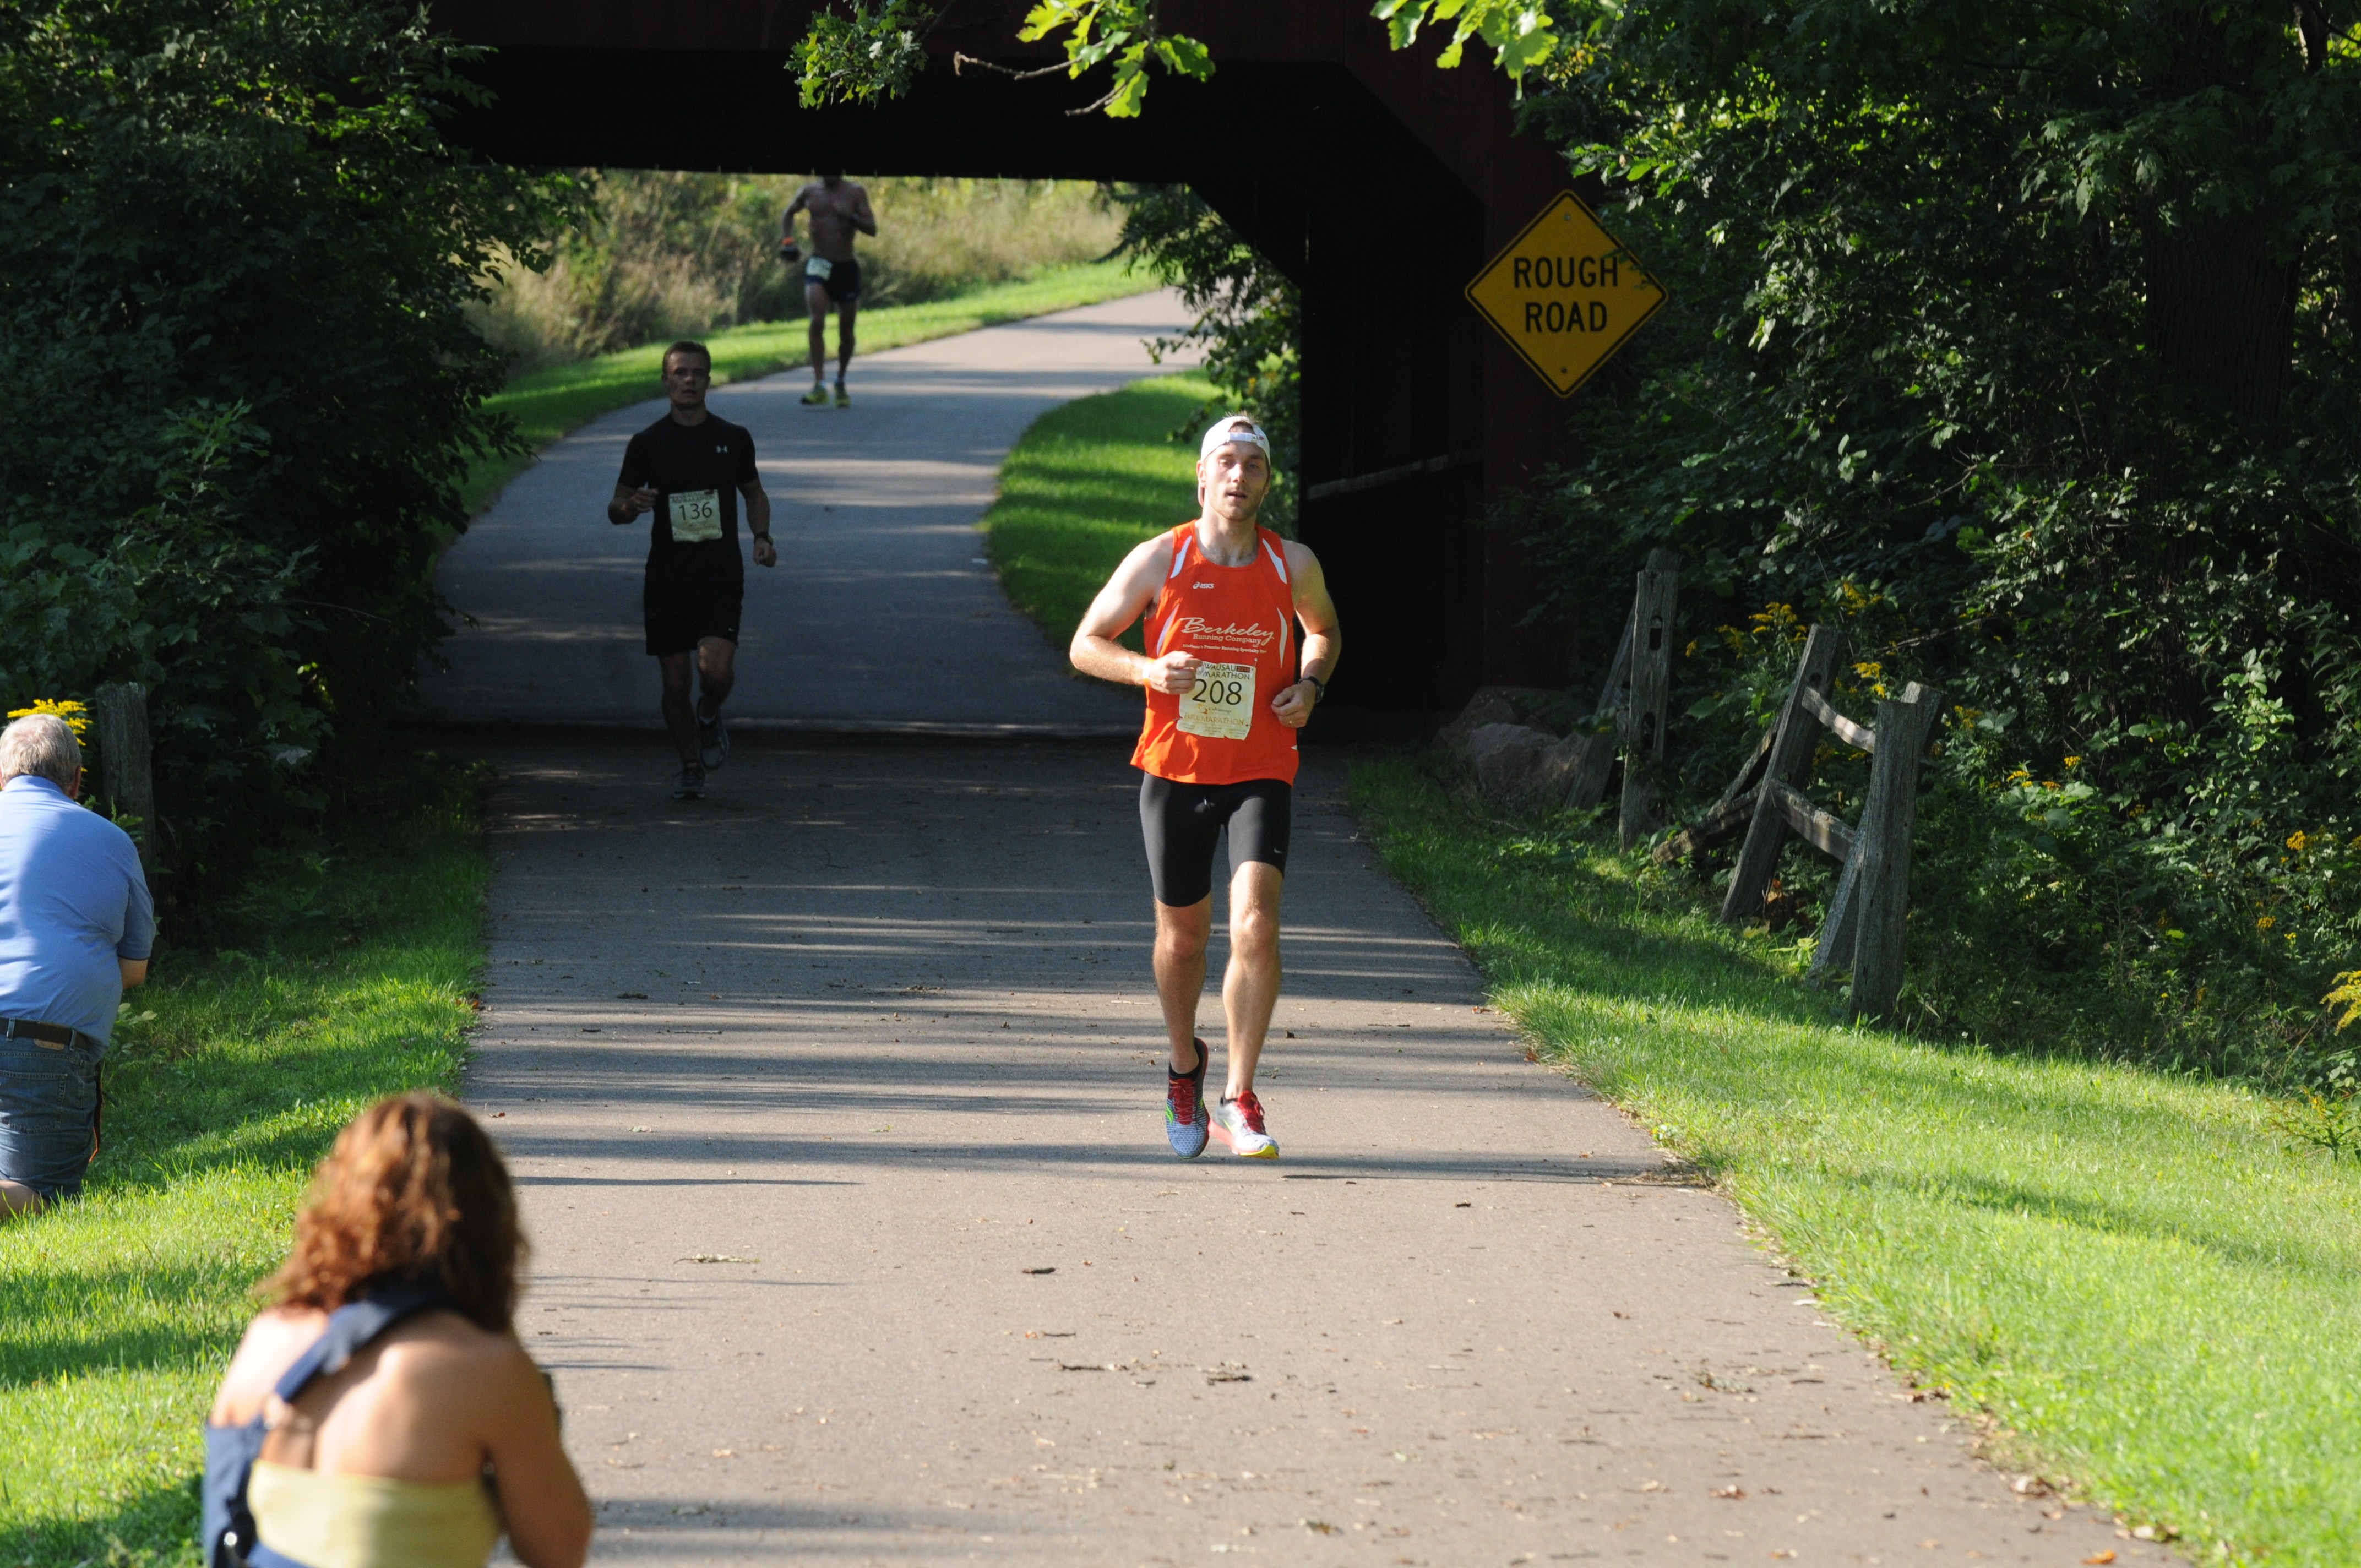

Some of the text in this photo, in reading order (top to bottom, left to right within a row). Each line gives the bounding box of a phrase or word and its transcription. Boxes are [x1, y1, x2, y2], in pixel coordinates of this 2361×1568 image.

[1514, 256, 1618, 288] ROUGH
[1525, 301, 1608, 333] ROAD
[678, 502, 712, 520] 136
[1180, 617, 1275, 646] Berkeley
[1225, 635, 1261, 645] Company
[1203, 671, 1250, 680] MARATHON
[1204, 662, 1236, 671] WAUSAU
[1192, 679, 1242, 705] 208
[1201, 716, 1244, 725] MARATHON
